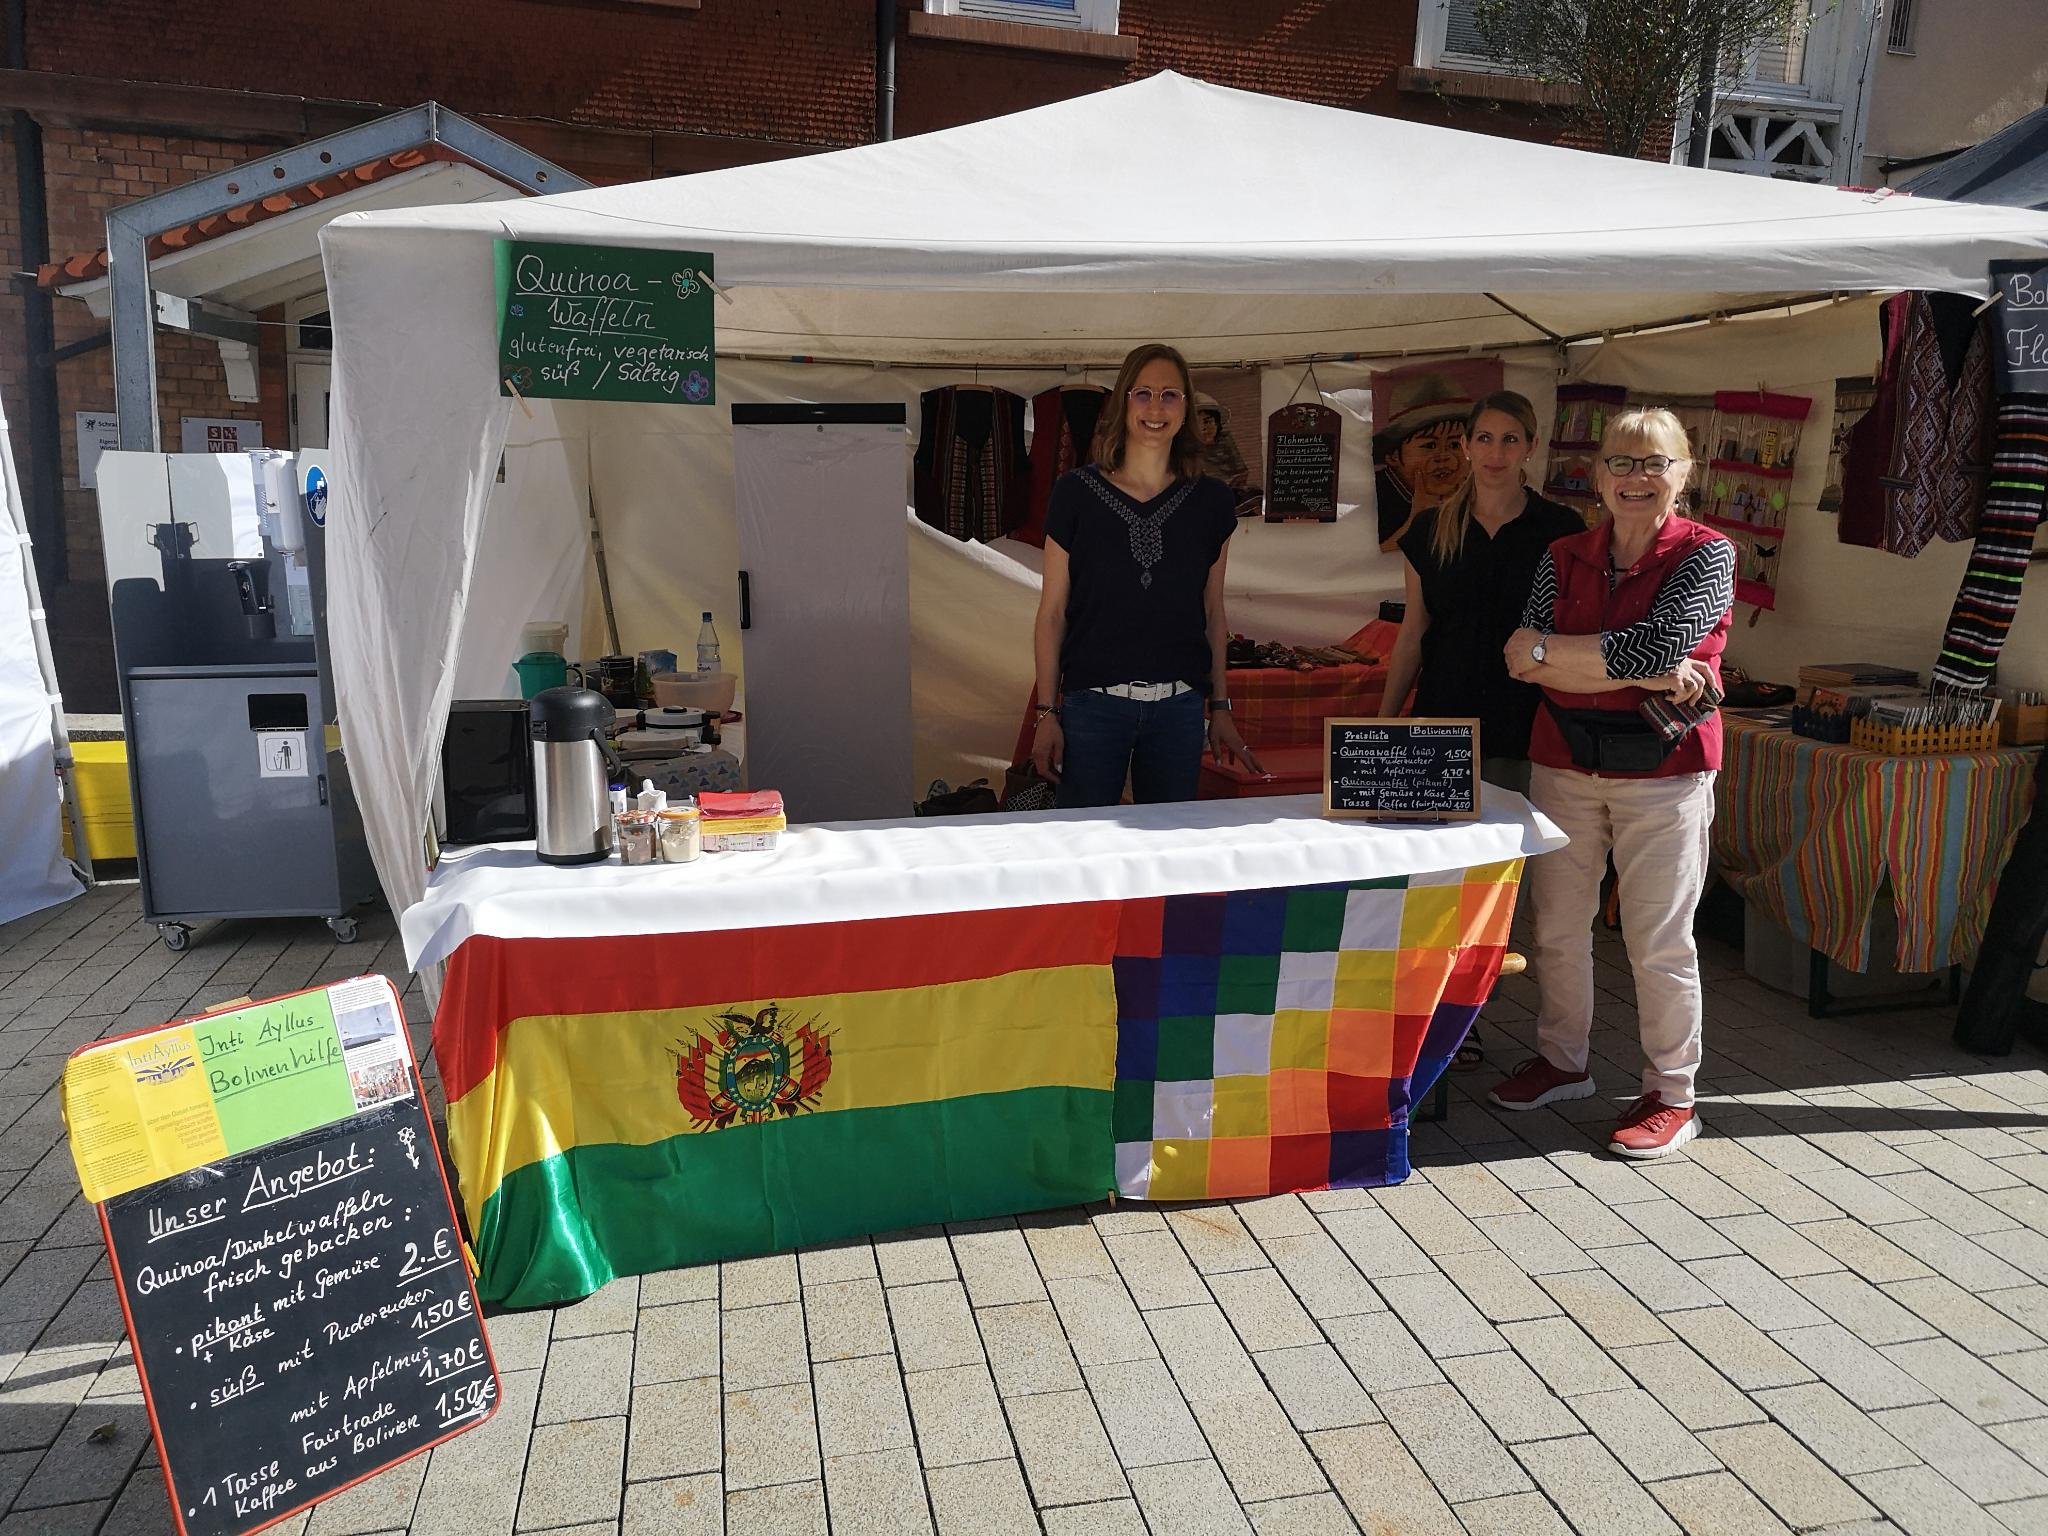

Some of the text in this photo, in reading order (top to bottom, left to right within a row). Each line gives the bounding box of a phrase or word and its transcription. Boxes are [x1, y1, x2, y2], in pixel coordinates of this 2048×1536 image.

[516, 254, 639, 294] Quinoa
[547, 296, 656, 336] Waffeln
[510, 332, 709, 366] glutenfrei, vegetarisch
[541, 360, 580, 386] süß
[1277, 434, 1323, 444] Flohmarkt
[1344, 730, 1389, 740] Preisliste
[1340, 746, 1407, 759] Quinoawaffel
[1340, 777, 1408, 789] Quinoawaffel
[1383, 767, 1428, 777] Apfelmus
[1342, 798, 1371, 807] Tasse
[1378, 799, 1408, 809] Kaffee
[1379, 789, 1414, 799] Gemüse
[1423, 789, 1446, 798] Käse
[259, 1012, 315, 1043] Ayllus
[148, 1142, 376, 1237] Unser Angebot:
[203, 1266, 272, 1303] frisch
[192, 1303, 266, 1357] pikant
[273, 1284, 306, 1313] mit
[312, 1256, 381, 1299] Gemüse
[229, 1325, 276, 1353] Käse
[210, 1364, 258, 1404] süß
[278, 1338, 315, 1374] mit
[289, 1390, 331, 1424] mit
[343, 1346, 430, 1401] Apfelmus
[222, 1460, 281, 1497] Tasse
[302, 1402, 396, 1455] Fairtrade
[234, 1414, 421, 1519] Kaffee aus Bolivien
